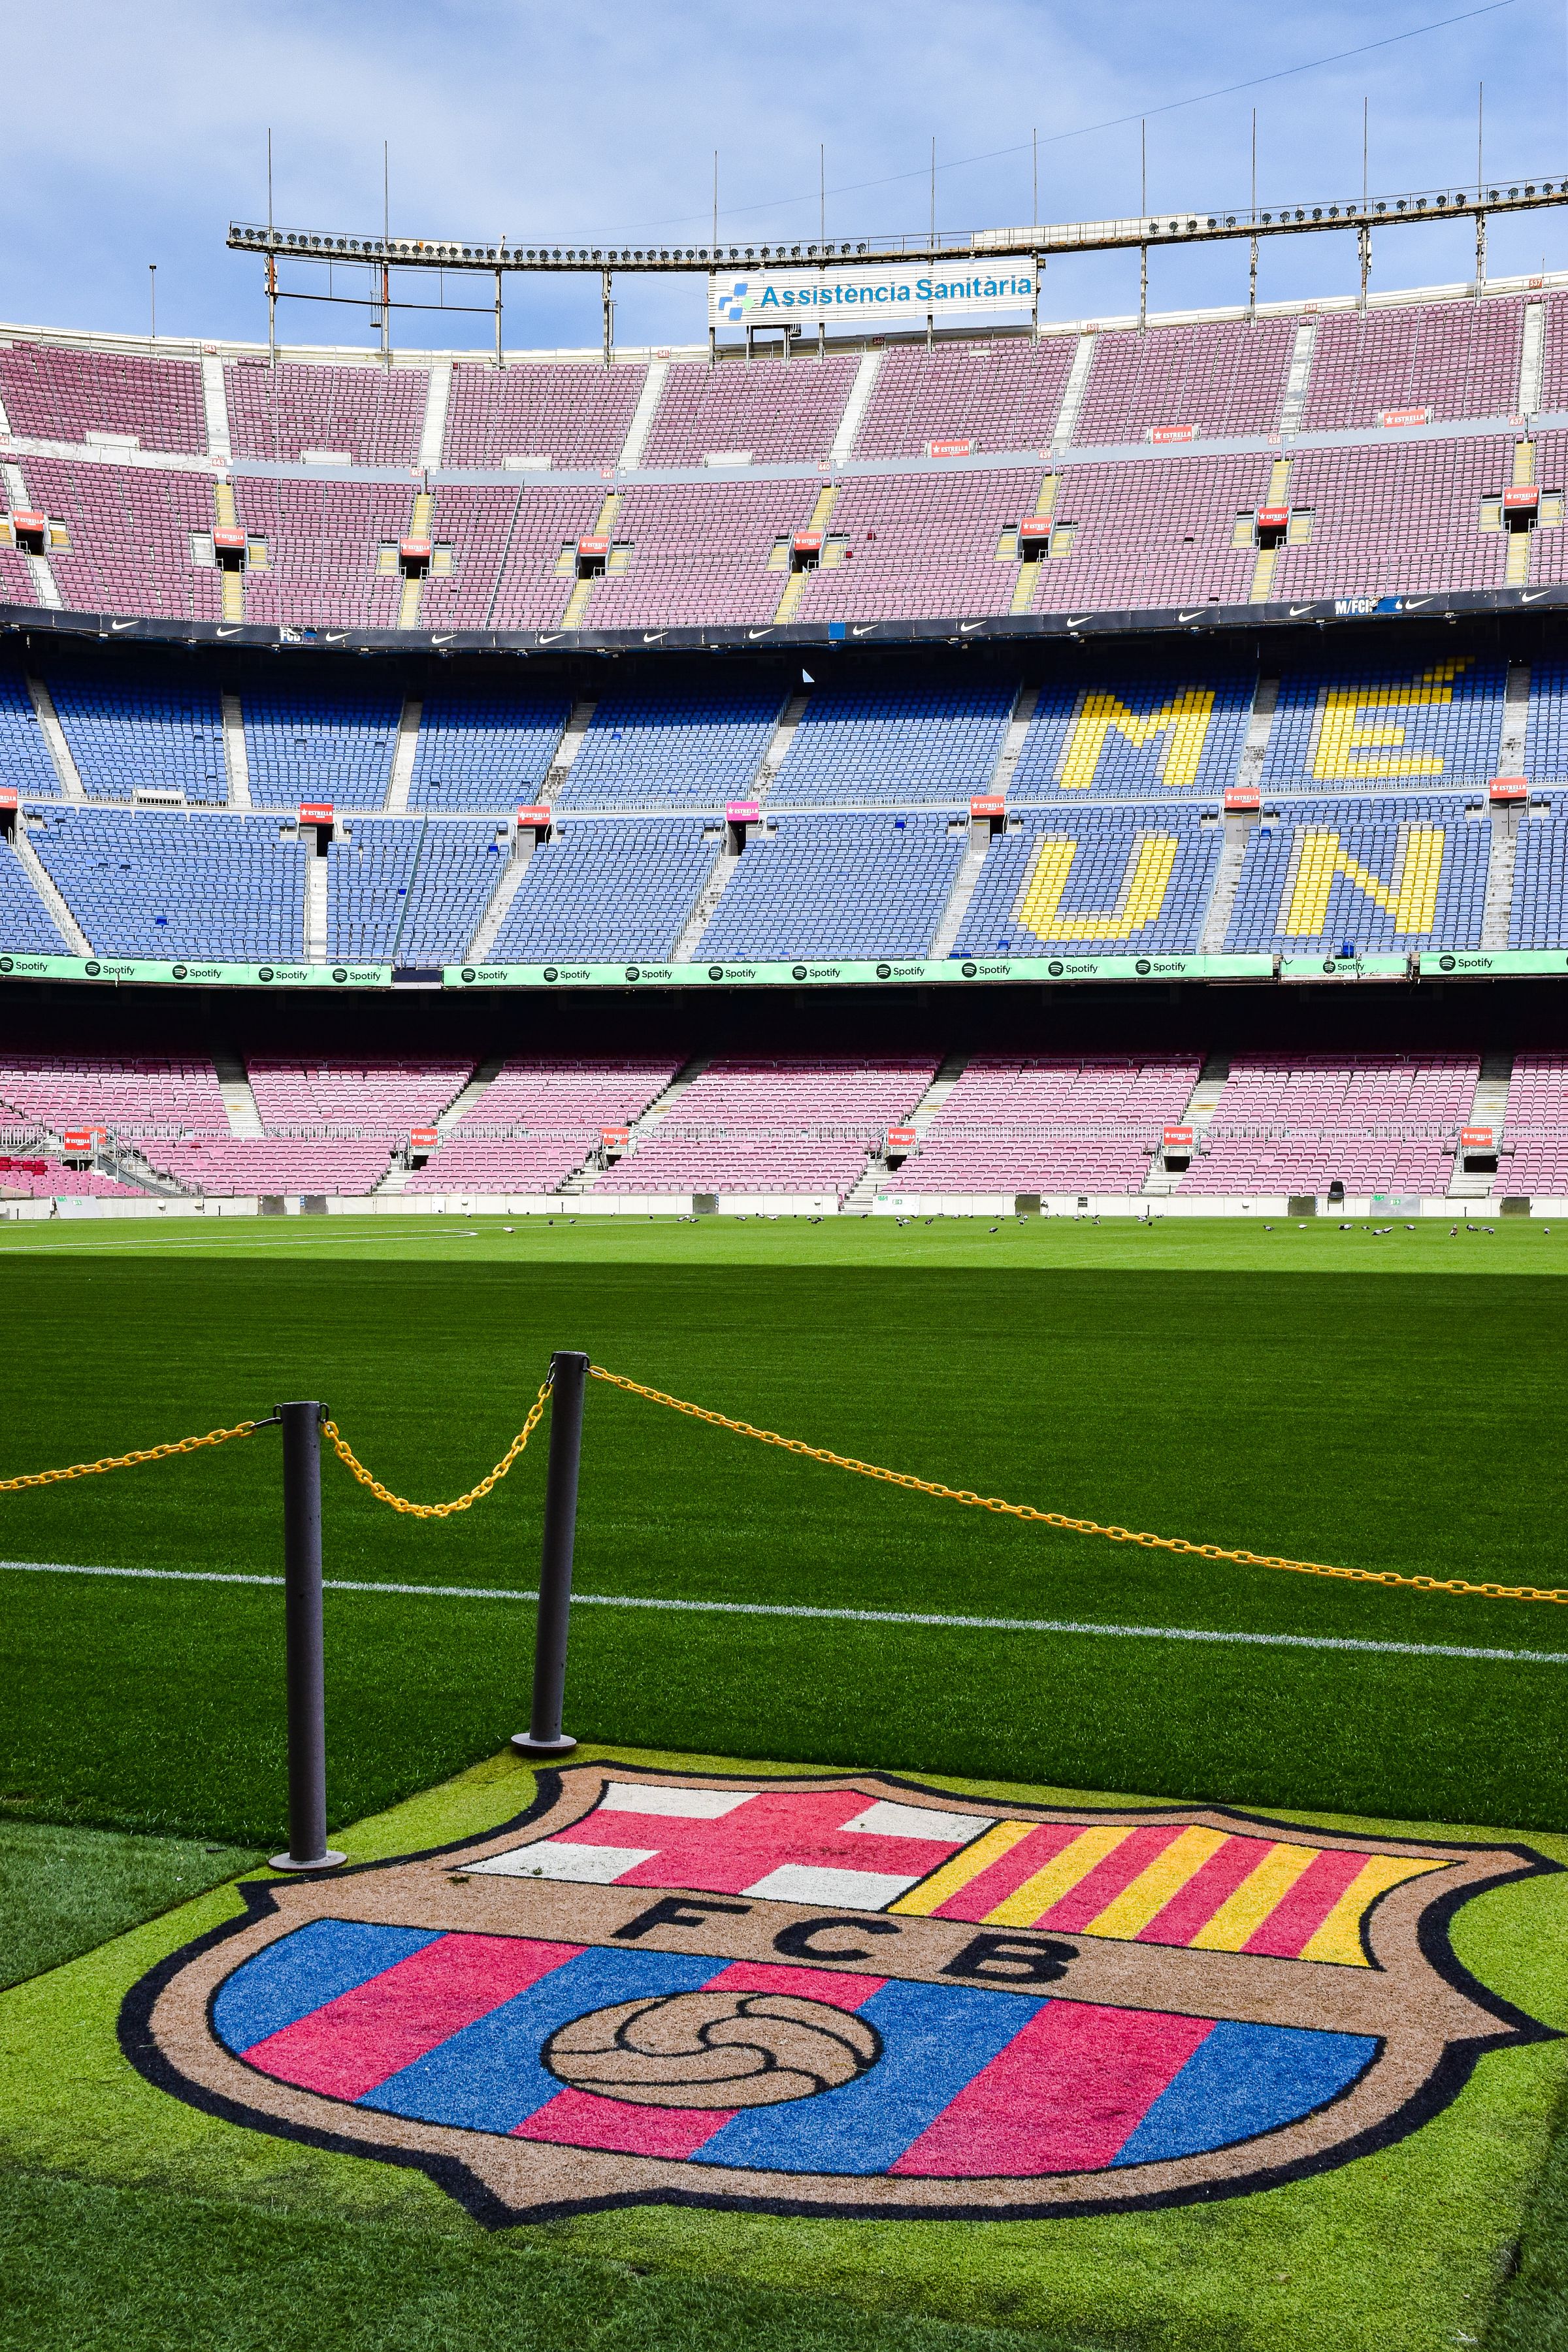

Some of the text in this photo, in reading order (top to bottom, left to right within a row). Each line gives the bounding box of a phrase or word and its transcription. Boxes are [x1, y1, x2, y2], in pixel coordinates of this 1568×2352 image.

[760, 274, 1032, 307] Assistència Sanitària
[16, 962, 48, 972] Spotify
[1154, 962, 1185, 972] Spotify
[1458, 958, 1493, 968] Spotify
[103, 966, 135, 975] Spotify
[809, 968, 840, 977] Spotify
[894, 967, 924, 976] Spotify
[979, 966, 1010, 975] Spotify
[1066, 964, 1098, 973] Spotify
[189, 969, 221, 979] Spotify
[276, 971, 308, 980] Spotify
[350, 972, 380, 981] Spotify
[478, 971, 508, 980] Spotify
[561, 970, 591, 979] Spotify
[642, 970, 672, 979] Spotify
[725, 969, 756, 978] Spotify
[610, 1896, 1079, 1985] FCB
